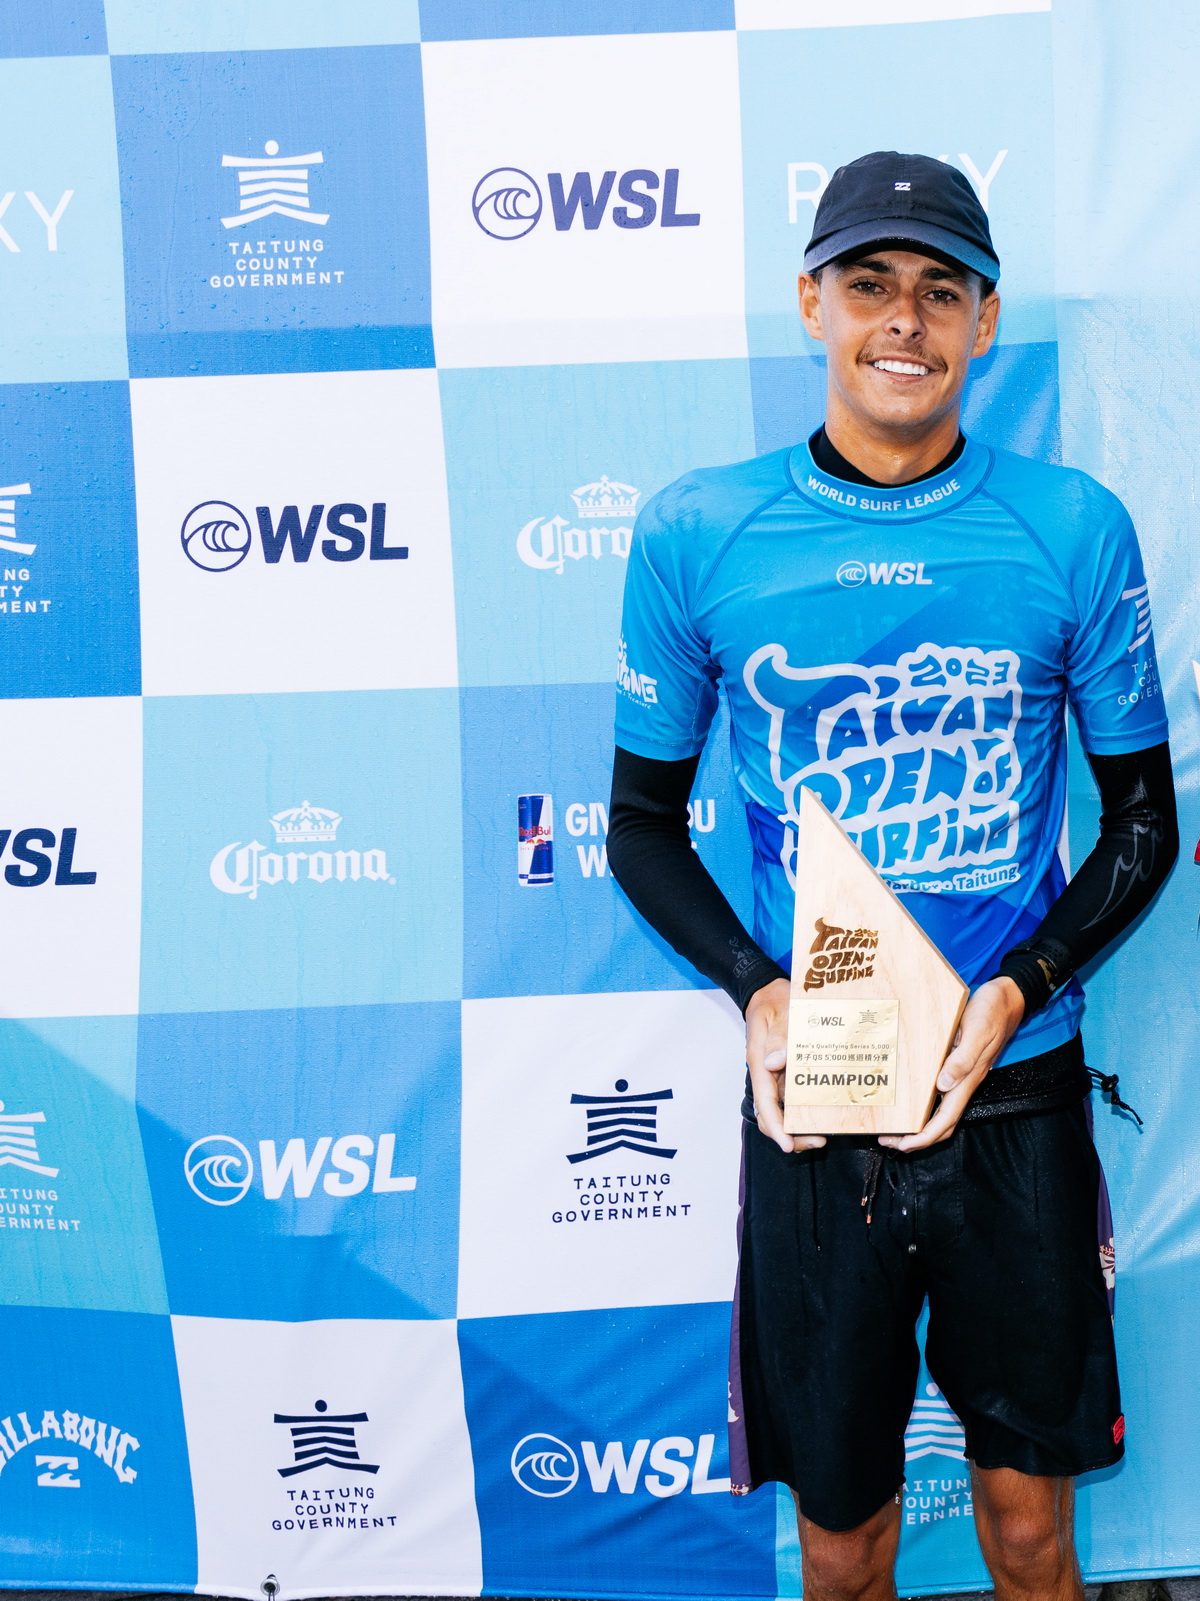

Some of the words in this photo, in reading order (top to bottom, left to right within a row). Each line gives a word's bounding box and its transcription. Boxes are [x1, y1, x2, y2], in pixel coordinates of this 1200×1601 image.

[548, 168, 701, 231] WSL
[229, 239, 324, 255] TAITUNG
[236, 256, 318, 271] COUNTY
[210, 271, 345, 288] GOVERNMENT
[807, 474, 857, 507] WORLD
[859, 498, 902, 511] SURF
[905, 478, 961, 510] LEAGUE
[256, 502, 409, 564] WSL
[868, 561, 933, 586] WSL
[908, 653, 1011, 688] 2023
[753, 655, 1013, 782] TAIWAN
[793, 745, 968, 822] OPEN
[0, 827, 97, 887] SL
[210, 839, 391, 900] Corona
[956, 865, 1018, 890] Taitung
[809, 916, 879, 955] TAIWAN
[812, 951, 865, 971] OPEN
[803, 964, 875, 993] SURFING
[821, 1016, 845, 1027] WSL
[816, 1043, 849, 1051] Qualifying
[794, 1073, 889, 1087] CHAMPION
[259, 1133, 418, 1200] WSL
[574, 1173, 671, 1190] TAITUNG
[580, 1190, 664, 1206] COUNTY
[552, 1204, 692, 1224] GOVERNMENT
[0, 1408, 141, 1485] ILLABONG
[582, 1433, 731, 1495] WSL
[286, 1486, 375, 1501] TAITUNG
[295, 1501, 369, 1516] COUNTY
[271, 1515, 398, 1531] GOVERNMENT
